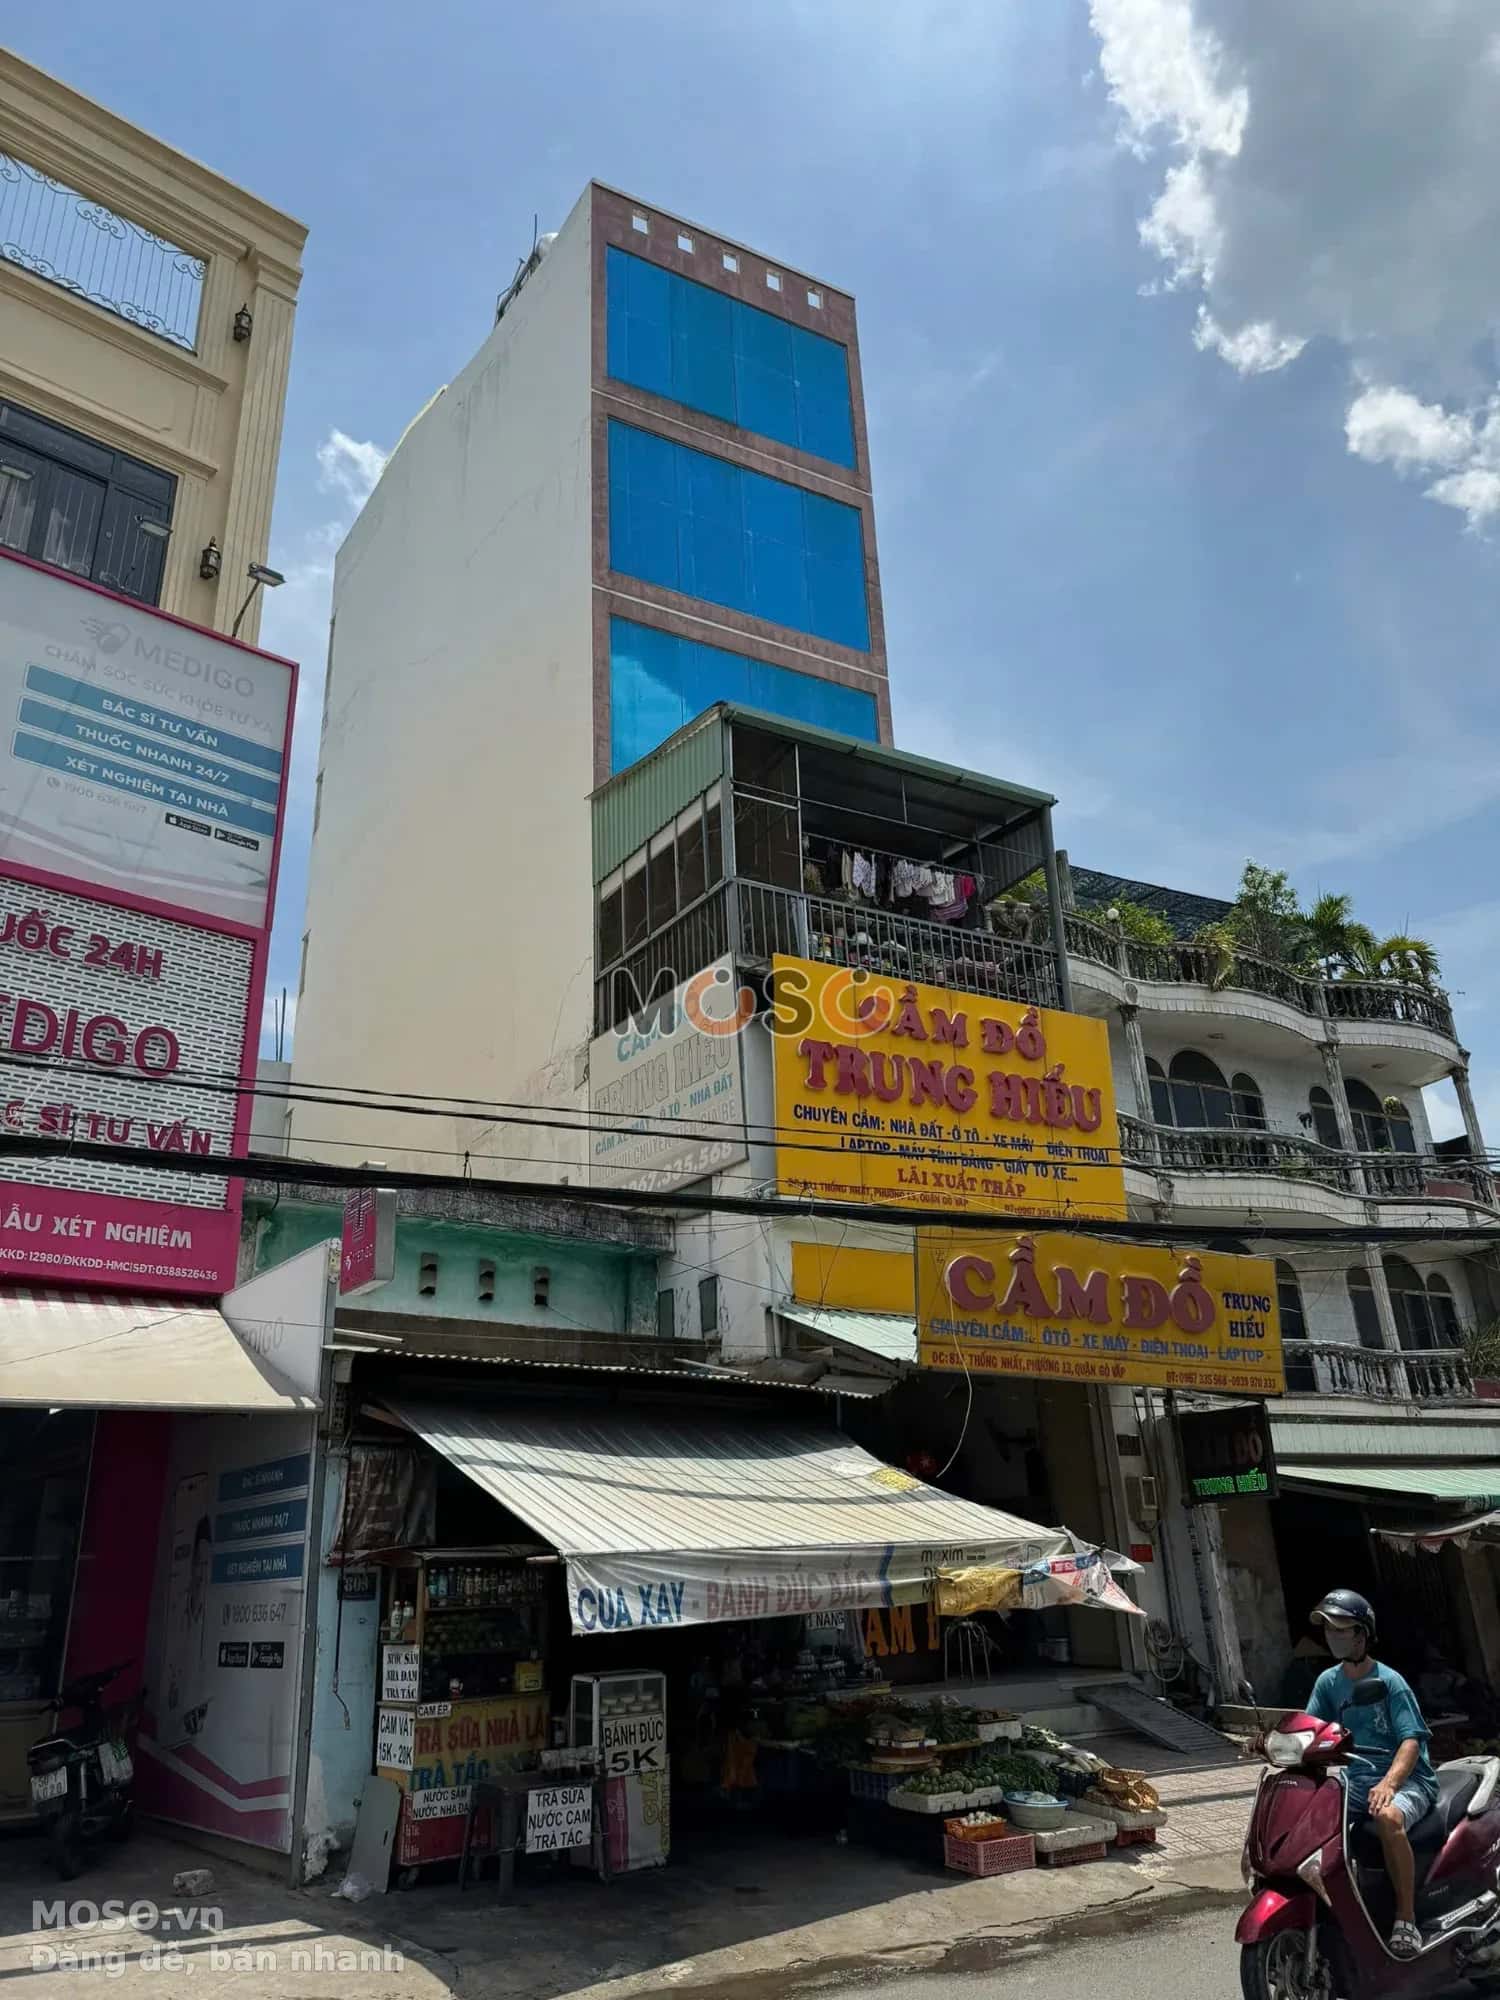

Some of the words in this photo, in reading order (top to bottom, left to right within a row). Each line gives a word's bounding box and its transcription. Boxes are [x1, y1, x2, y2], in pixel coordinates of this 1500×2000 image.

[134, 637, 255, 697] MEDIGO
[102, 698, 136, 719] BÁC
[160, 718, 182, 735] TƯ
[186, 724, 218, 748] VẤN
[75, 724, 132, 752] THUỐC
[136, 745, 192, 771] NHANH
[195, 765, 230, 783] 24/7
[64, 755, 98, 775] XÉT
[102, 767, 164, 797] NGHIỆM
[168, 789, 192, 807] TẠI
[196, 798, 229, 817] NHÀ
[84, 933, 164, 980] 24H
[858, 985, 970, 1048] CẦM
[980, 1006, 1048, 1061] ĐỒ
[799, 1038, 979, 1113] TRUNG
[987, 1063, 1102, 1133] HIẾU
[84, 1112, 136, 1144] TƯ
[145, 1117, 213, 1155] VẤN
[793, 1104, 848, 1126] CHUYÊN
[852, 1109, 885, 1131] CẦM:
[890, 1117, 917, 1136] NHÀ
[920, 1119, 944, 1139] ĐẤT
[897, 1165, 928, 1187] LÃI
[932, 1169, 978, 1192] XUẤT
[981, 1176, 1026, 1198] THẤP
[0, 1203, 42, 1232] ẪU
[51, 1214, 97, 1239] XÉT
[104, 1222, 194, 1249] NGHIỆM
[946, 1233, 1111, 1325] CẦM
[1120, 1254, 1216, 1335] ĐỒ
[1222, 1292, 1272, 1313] TRUNG
[930, 1318, 989, 1339] CHUYÊN
[1082, 1333, 1099, 1349] XE
[1102, 1330, 1131, 1351] MÁY
[1141, 1337, 1169, 1357] ĐIỆN
[1217, 1345, 1265, 1362] LAPTOP
[1229, 1315, 1266, 1338] HIẾU
[638, 1581, 686, 1626] XAY
[705, 1565, 770, 1620] BÁNH
[380, 1714, 398, 1735] CAM
[418, 1705, 437, 1717] CAM
[605, 1721, 637, 1748] BÁNH
[639, 1716, 664, 1744] ĐÚC
[397, 1744, 412, 1766] 20K
[611, 1745, 659, 1773] 5K
[423, 1790, 449, 1804] NƯỚC
[440, 1802, 457, 1815] NHA
[535, 1789, 559, 1808] TRÀ
[528, 1809, 563, 1830] NƯỚC
[566, 1809, 591, 1826] CAM
[534, 1830, 558, 1850] TRÀ
